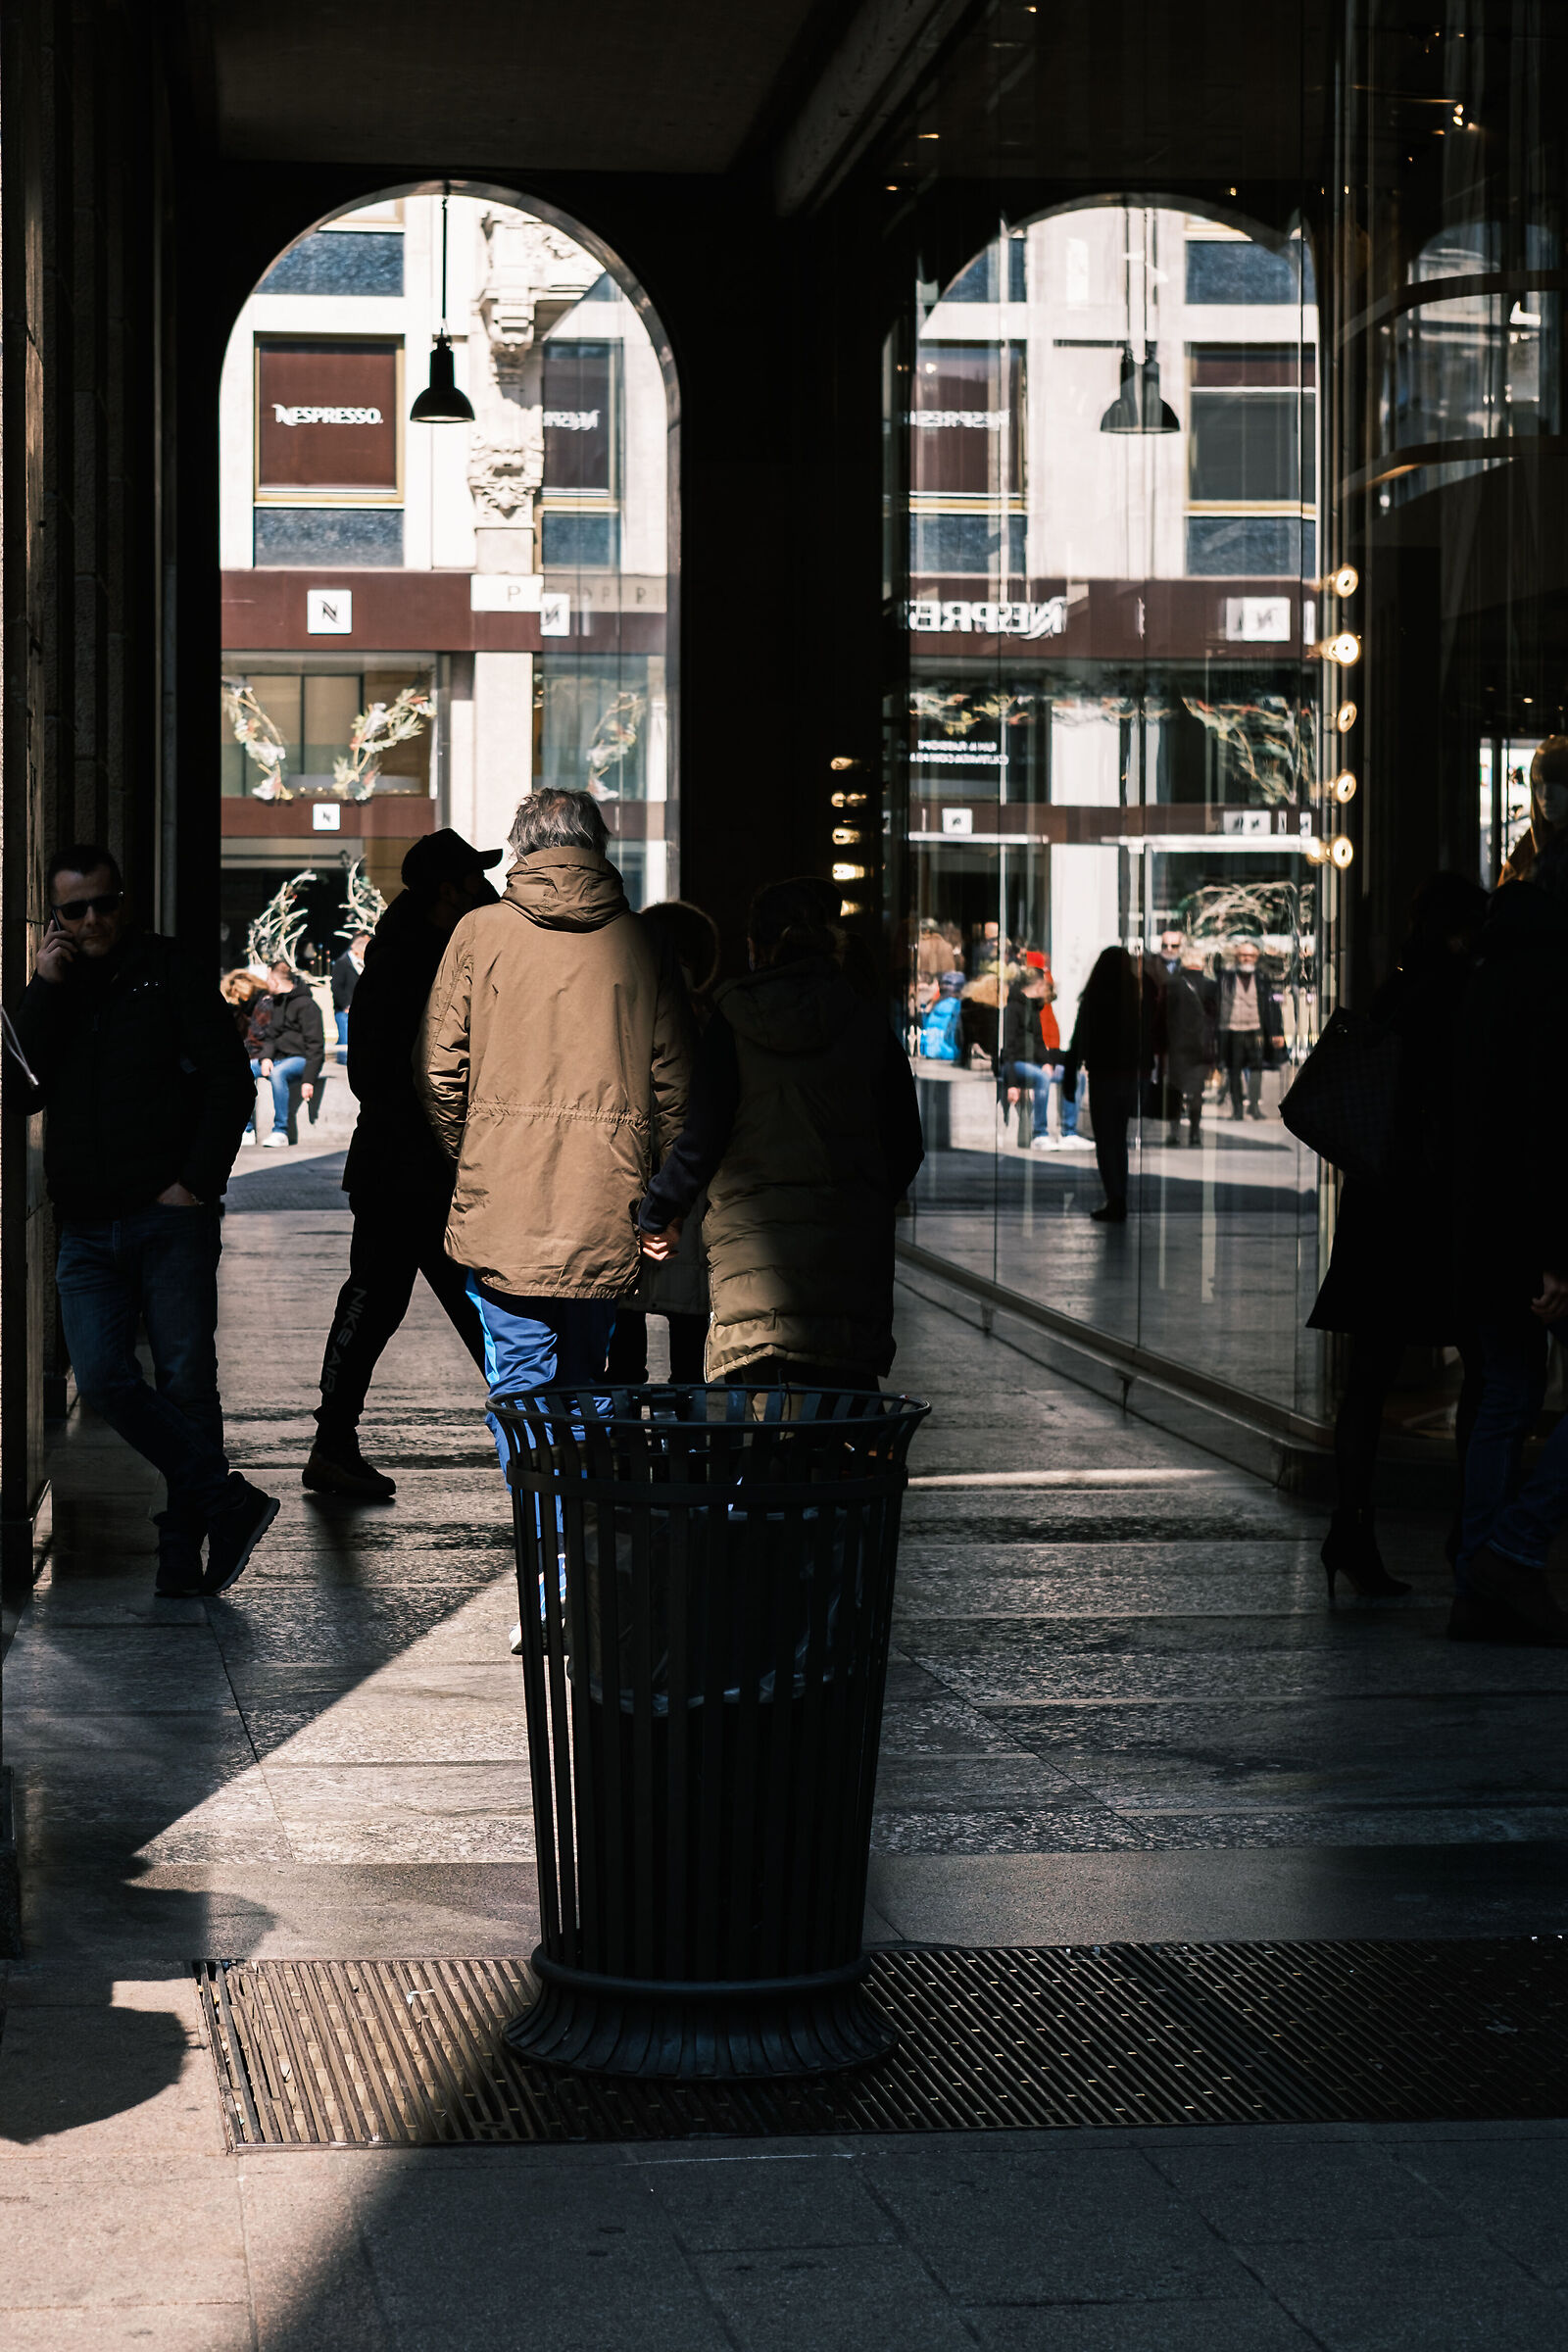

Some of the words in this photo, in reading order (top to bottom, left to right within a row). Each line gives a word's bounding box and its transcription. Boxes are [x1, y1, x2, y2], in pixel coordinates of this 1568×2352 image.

[272, 404, 383, 426] NESPRESSO
[337, 1286, 368, 1347] NIKE
[321, 1347, 342, 1395] AIR
